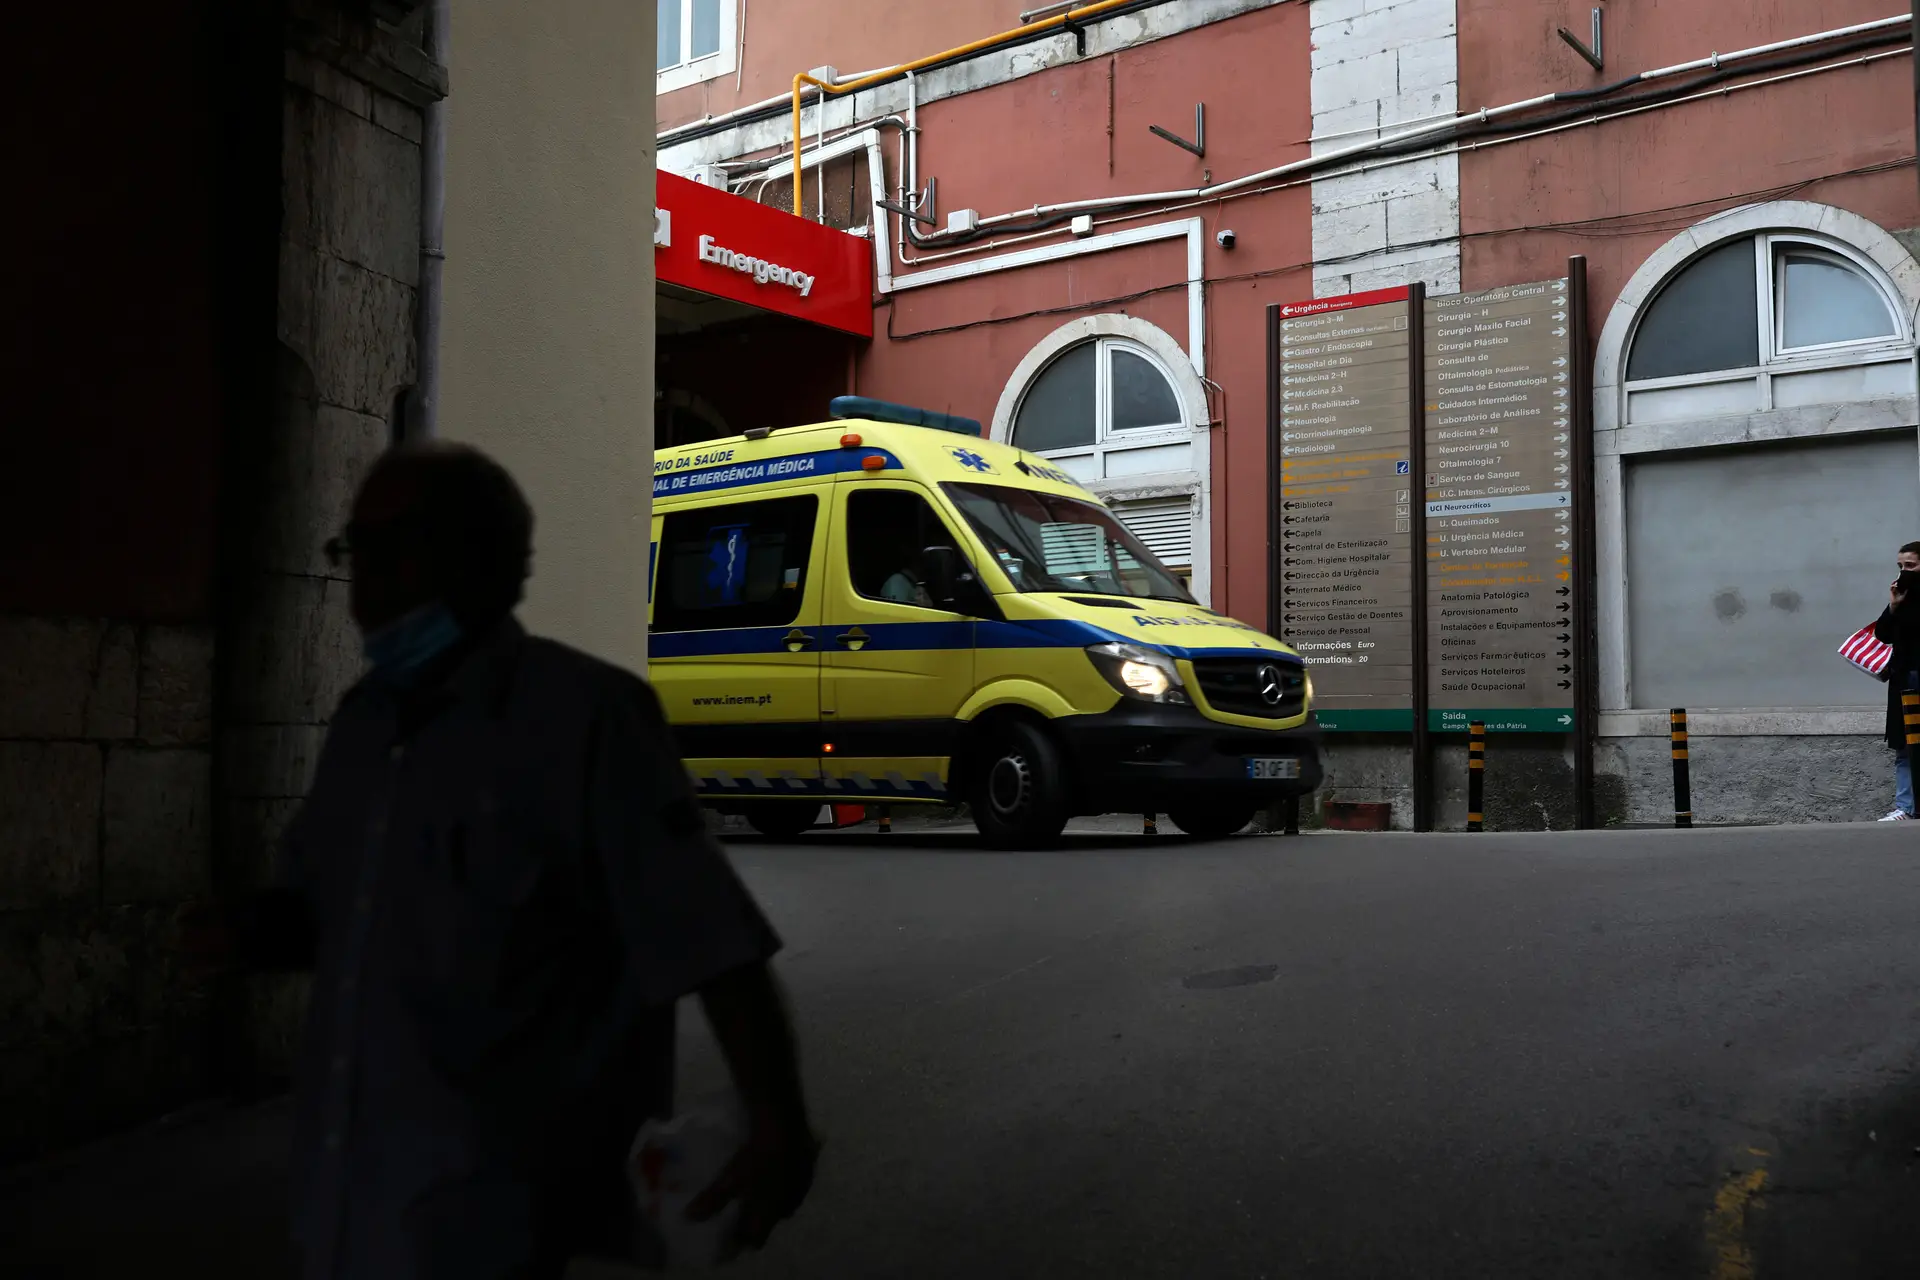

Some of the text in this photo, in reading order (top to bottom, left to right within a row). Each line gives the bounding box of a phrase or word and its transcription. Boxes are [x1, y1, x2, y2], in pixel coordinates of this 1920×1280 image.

[699, 234, 815, 297] Emergency
[1463, 291, 1510, 305] Operatório
[1512, 285, 1545, 297] Central
[1294, 302, 1329, 314] Urgência
[1294, 318, 1325, 329] Cirurgia
[1437, 312, 1471, 323] Cirurgia
[1474, 322, 1503, 332] Maxilo
[1505, 317, 1531, 328] Facial
[1294, 330, 1331, 342] Consultas
[1332, 326, 1365, 337] Externas
[1295, 345, 1320, 356] Gastro
[1327, 339, 1373, 352] Endoscopia
[1437, 336, 1509, 352] Cirurgia Plástica
[1294, 356, 1352, 372] Hospital de Dia
[1438, 355, 1476, 366] Consulta
[1294, 373, 1329, 384] Medicina
[1438, 365, 1530, 381] Oftalmologia Pediátrica
[1438, 377, 1548, 395] Consulta de Estomatologia
[1311, 396, 1360, 409] Reabilitação
[1438, 399, 1477, 410] Cuidados
[1478, 394, 1528, 406] Intermédios
[1294, 415, 1337, 426] Neurologia
[1438, 408, 1541, 425] Laboratório de Análises
[1294, 425, 1372, 439] Otorrinolaringologia
[1438, 428, 1477, 439] Medicina
[1294, 443, 1336, 454] Radiologia
[1439, 440, 1510, 454] Neurocirurgia 10
[654, 449, 735, 472] RIO DA SAÚDE
[1439, 456, 1502, 469] Oftalmologia 7
[671, 476, 688, 490] DE
[689, 466, 766, 487] EMERGÊNCIA
[767, 458, 815, 476] MÉDICA
[1439, 470, 1520, 483] Serviço de Sangue
[1439, 489, 1456, 498] U.C.
[1458, 488, 1486, 497] Intens.
[1487, 484, 1531, 495] Cirúrgicos
[1294, 501, 1333, 509] Biblioteca
[1430, 504, 1443, 512] UCI
[1295, 514, 1330, 524] Cafetaria
[1440, 517, 1500, 528] U. Queimados
[1295, 529, 1322, 538] Capela
[1440, 534, 1449, 542] U.
[1451, 531, 1490, 543] Urgência
[1492, 529, 1524, 539] Médica
[1295, 543, 1323, 552] Central
[1337, 539, 1388, 549] Esterilização
[1440, 549, 1449, 557] U.
[1451, 546, 1488, 556] Vertebro
[1490, 545, 1527, 554] Medular
[1295, 553, 1391, 566] Com. Higiene Hospitalar
[1295, 571, 1329, 581] Direcção
[1343, 568, 1380, 578] Urgência
[1295, 584, 1362, 594] Internato Médico
[1440, 591, 1530, 602] Anatomia Patológica
[1296, 598, 1378, 608] Serviços Financeiros
[1296, 614, 1326, 623] Serviço
[1328, 611, 1355, 621] Gestão
[1369, 611, 1403, 619] Doentes
[1441, 607, 1519, 618] Aprovisionamento
[1296, 626, 1371, 637] Serviço de Pessoal
[1441, 622, 1487, 631] Instalações
[1496, 620, 1557, 631] Equipamentos
[1296, 640, 1352, 651] Informações
[1441, 638, 1476, 646] Oficinas
[1300, 655, 1368, 664] nformations 20
[1441, 653, 1478, 662] Serviços
[1441, 667, 1526, 677] Serviços Hoteleiros
[1441, 682, 1526, 692] Saúde Ocupacional
[692, 693, 772, 706] www.inem.pt
